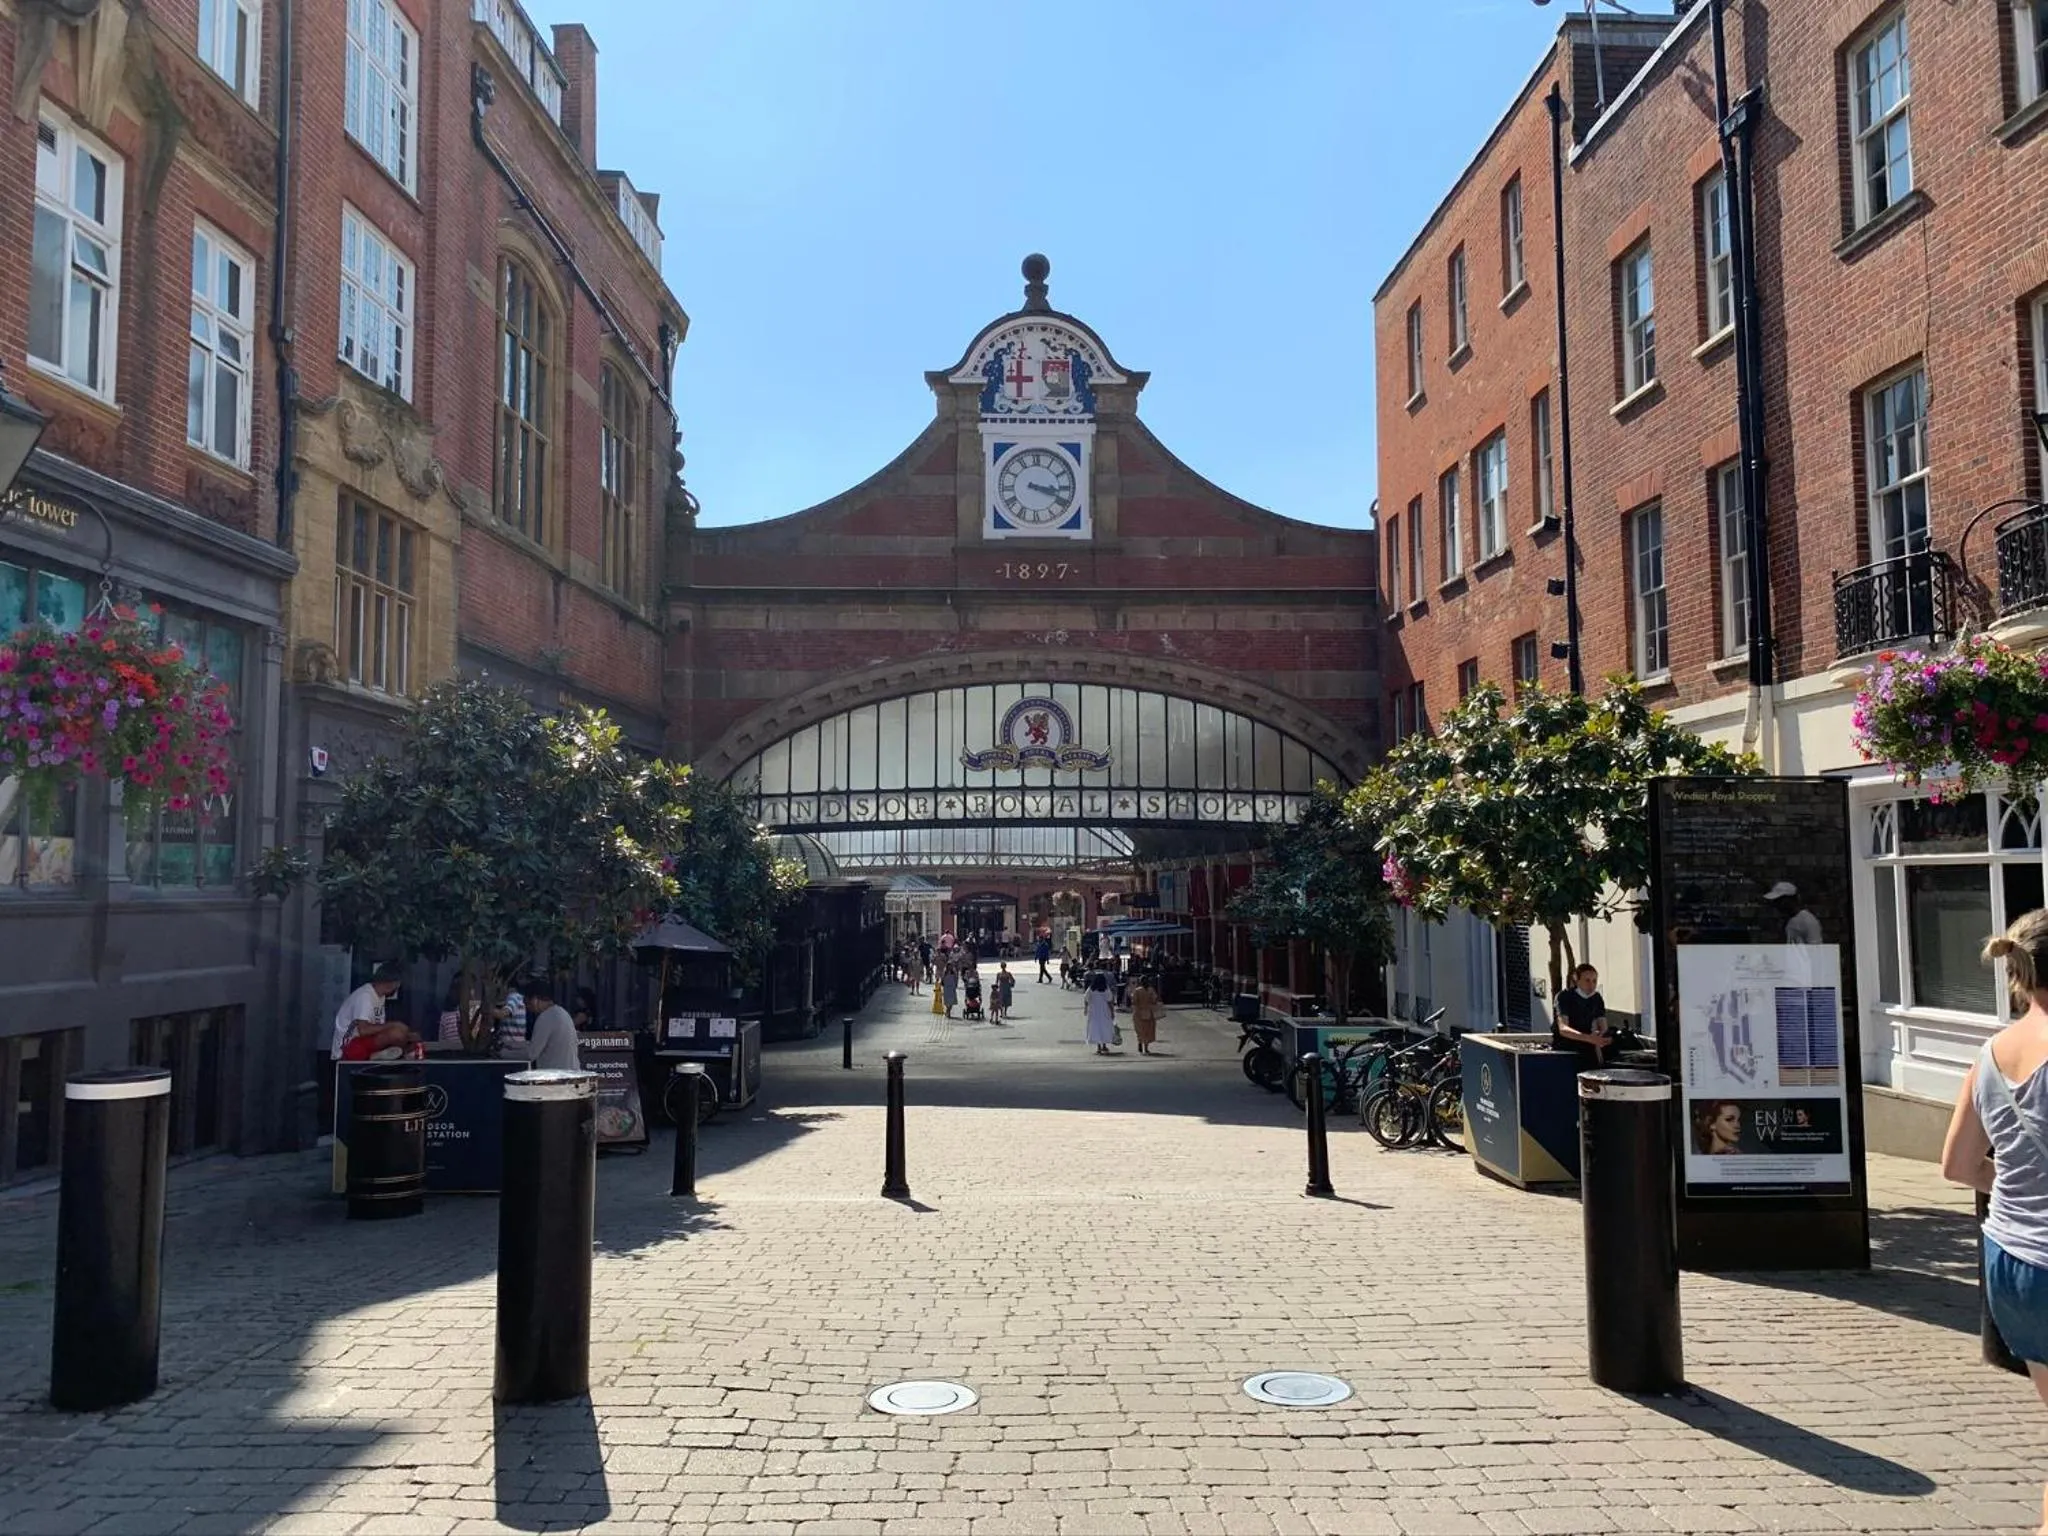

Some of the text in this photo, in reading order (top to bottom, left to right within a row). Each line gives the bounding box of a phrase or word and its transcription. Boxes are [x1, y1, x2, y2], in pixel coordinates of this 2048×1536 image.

[1672, 790, 1709, 801] Windsor
[1711, 790, 1736, 804] Royal
[766, 795, 929, 820] INDSOR
[973, 795, 1103, 814] ROYAL
[1754, 1110, 1778, 1126] EN
[426, 1131, 470, 1139] STATION
[1756, 1126, 1778, 1141] VY
